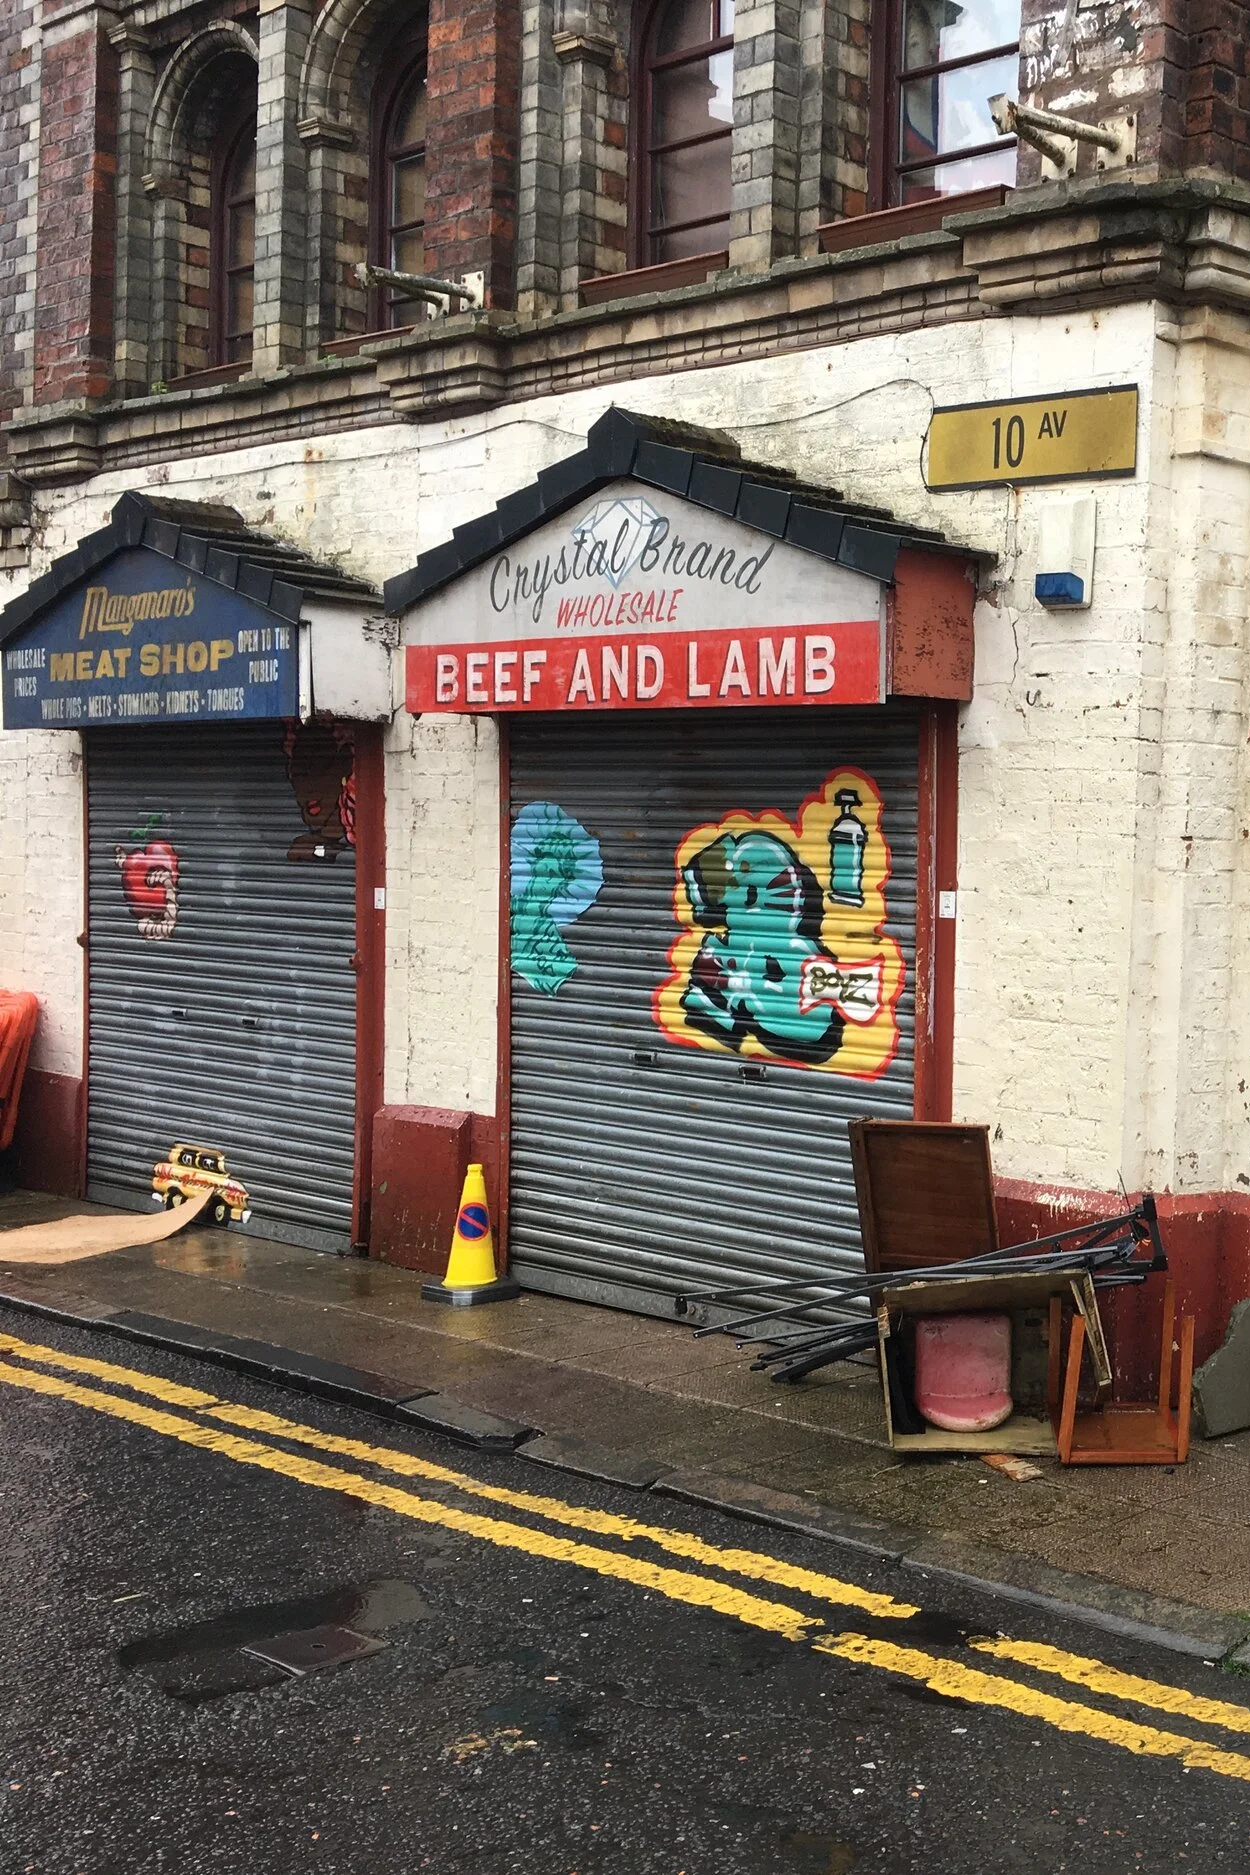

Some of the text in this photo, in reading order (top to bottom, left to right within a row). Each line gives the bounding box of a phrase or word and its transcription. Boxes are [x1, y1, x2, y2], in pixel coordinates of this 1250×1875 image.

[991, 410, 1068, 470] 10 AV
[490, 517, 775, 624] Crystal Brand
[78, 577, 197, 640] Manganaro's
[557, 588, 684, 628] WHOLESALE
[6, 648, 46, 671] WHOLESALE
[49, 639, 234, 682] MEAT SHOP
[237, 627, 290, 654] OPEN TO THE
[14, 676, 37, 698] PRICES
[248, 659, 279, 684] PUBLIC
[435, 634, 837, 703] BEEF AND LAMB
[41, 687, 244, 720] WHOLE PIGS MELTS STOMACHS KIDNEYS TONGUES
